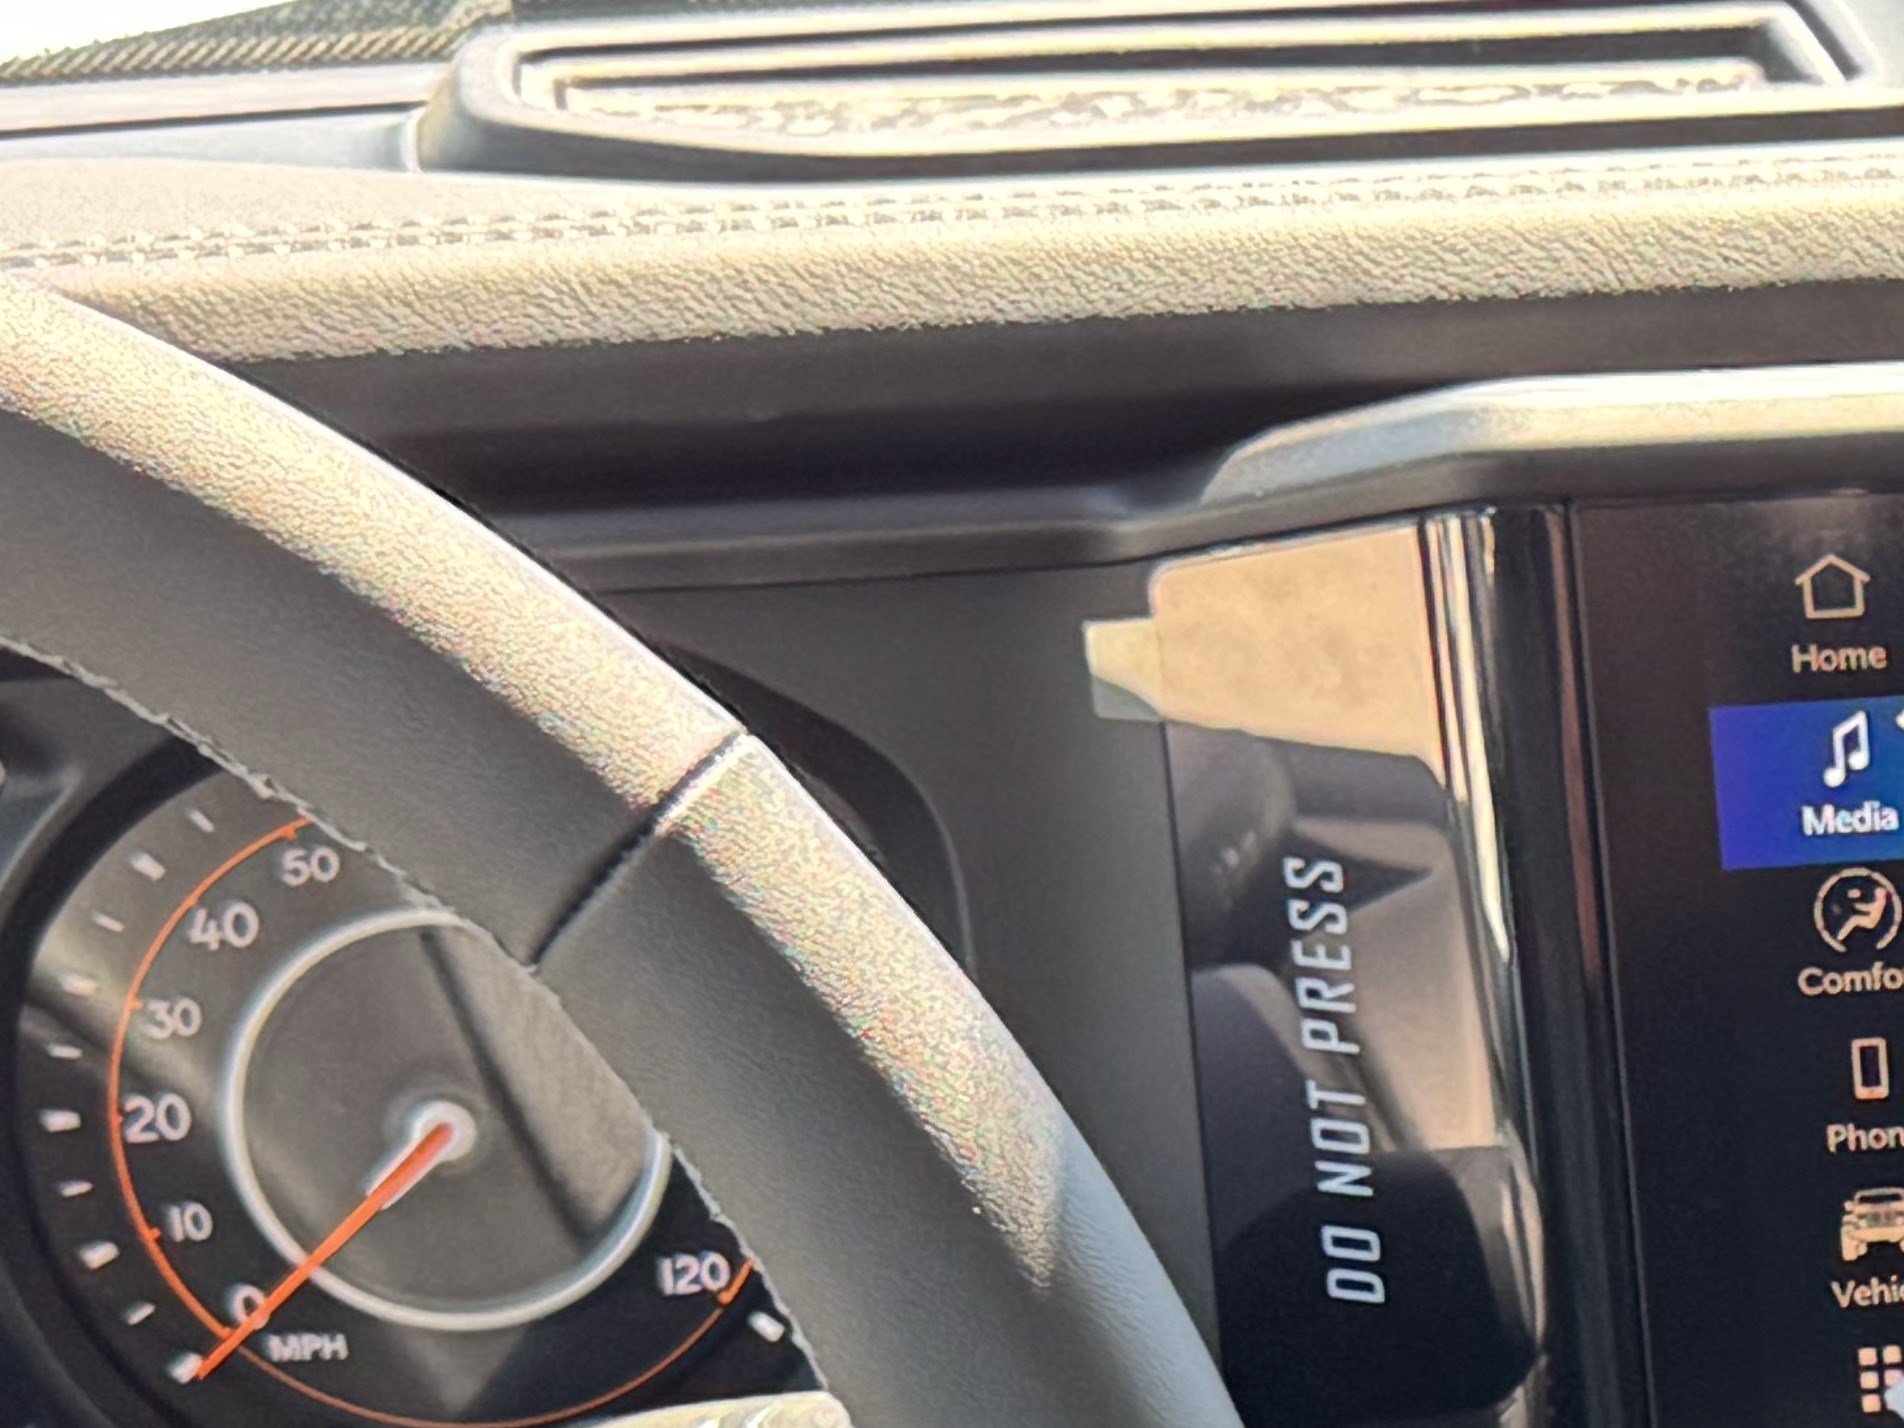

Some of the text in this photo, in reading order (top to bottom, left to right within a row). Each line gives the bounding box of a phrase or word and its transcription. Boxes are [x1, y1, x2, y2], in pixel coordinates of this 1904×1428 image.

[1792, 644, 1886, 673] Home
[1802, 802, 1898, 836] Media
[282, 848, 339, 883] 50
[190, 902, 258, 950] 40
[146, 1001, 200, 1037] 30
[1283, 857, 1385, 1304] DO NOT PRESS
[123, 1094, 190, 1142] 20
[169, 1205, 212, 1240] 10
[660, 1254, 728, 1295] 120
[267, 1333, 349, 1361] MPH
